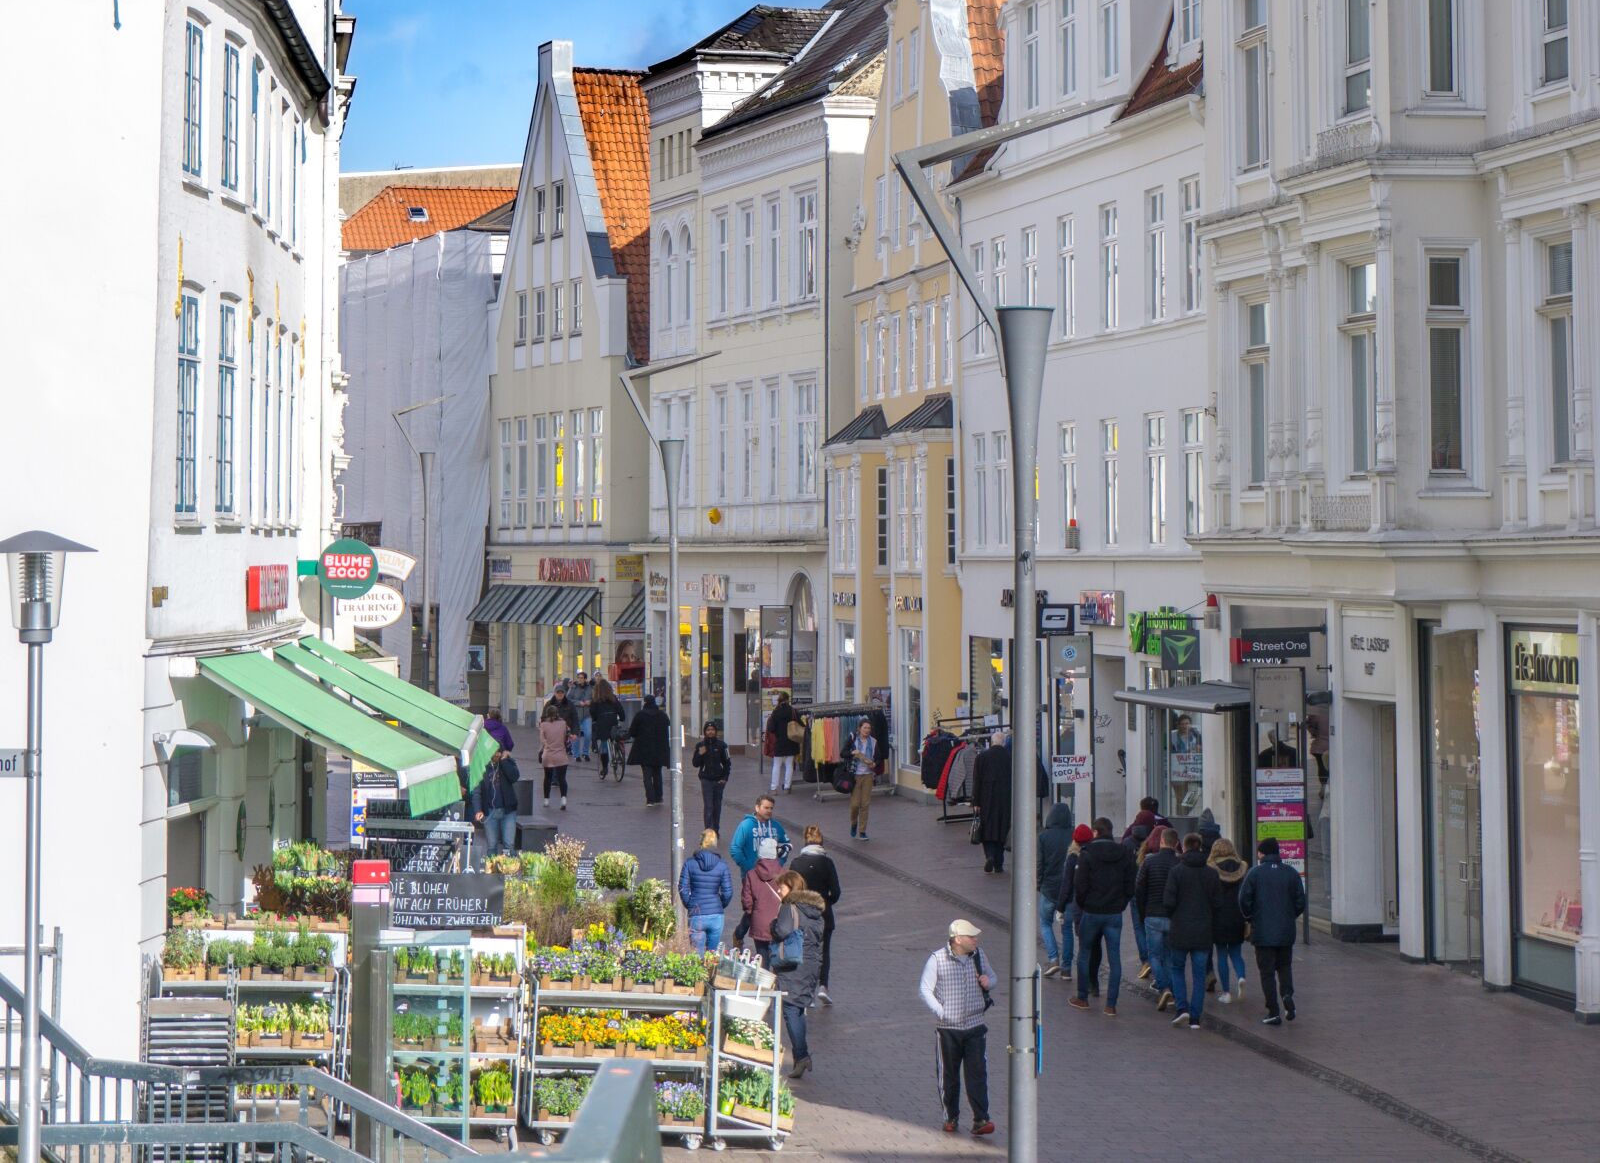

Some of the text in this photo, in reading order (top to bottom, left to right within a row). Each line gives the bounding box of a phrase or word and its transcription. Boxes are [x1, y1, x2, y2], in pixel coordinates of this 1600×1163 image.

[324, 554, 372, 568] BLUME
[328, 567, 368, 579] 2000
[354, 614, 388, 622] UHREN
[1252, 640, 1308, 651] Street One
[419, 844, 440, 861] FÜR
[437, 897, 488, 911] FRÜHER!
[393, 914, 502, 926] ÜHLING IST ZWIEBELZEIT!
